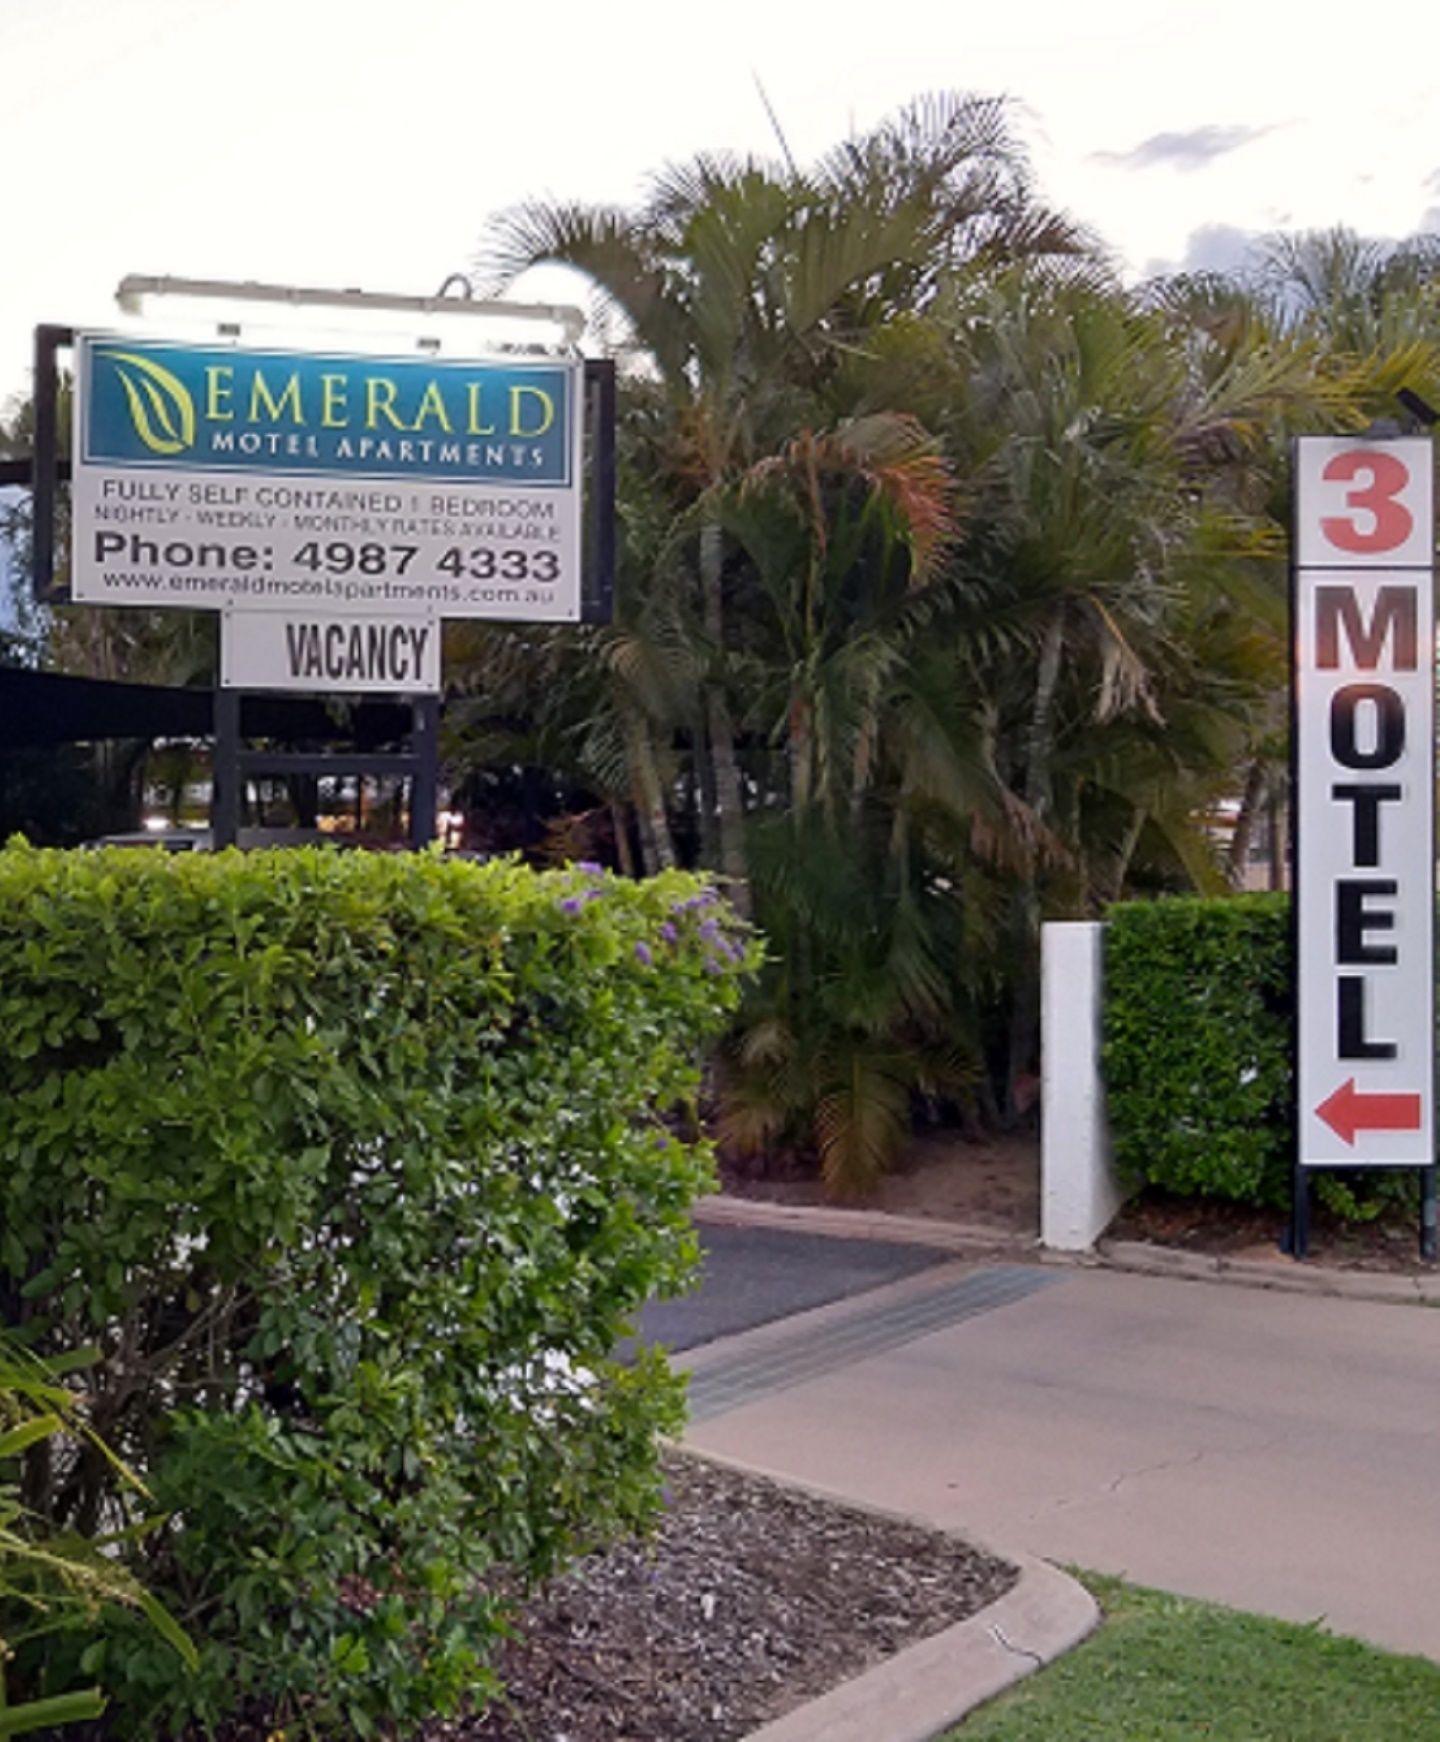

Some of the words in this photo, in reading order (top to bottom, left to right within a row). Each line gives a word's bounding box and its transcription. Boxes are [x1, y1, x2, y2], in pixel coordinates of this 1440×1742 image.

[204, 365, 555, 438] EMERALD
[212, 430, 319, 458] MOTEL
[336, 438, 543, 469] APARTMENTS
[94, 504, 180, 525] NIGHTLY
[197, 509, 277, 529] WEEKLY
[294, 515, 390, 534] MONTHLY
[392, 518, 456, 538] RATES
[461, 522, 560, 544] AVAILABLE
[103, 479, 181, 502] FULLY
[189, 484, 249, 506] SELF
[255, 487, 402, 514] CONTAINED
[431, 495, 555, 520] BEDROOM
[1319, 448, 1414, 555] 3
[95, 530, 274, 572] Phone:
[293, 540, 420, 576] 4987
[436, 546, 561, 584] 4333
[103, 572, 555, 605] www.emeraldmotelapartments.com.au
[286, 622, 429, 682] VACANCY
[1315, 585, 1418, 1060] MOTEL
